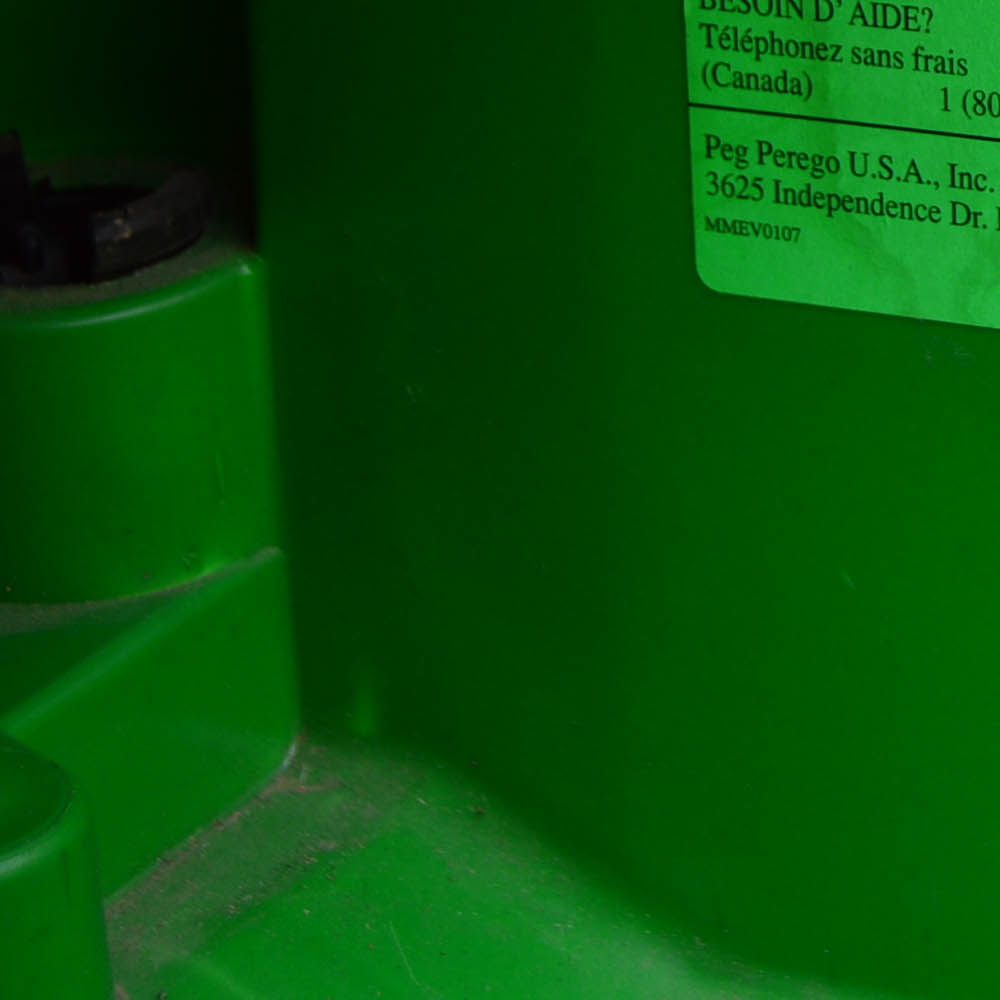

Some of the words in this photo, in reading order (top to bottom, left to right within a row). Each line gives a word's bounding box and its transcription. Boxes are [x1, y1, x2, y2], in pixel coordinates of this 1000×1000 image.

[848, 0, 934, 34] AIDE?
[698, 22, 844, 63] Téléphonez
[850, 45, 905, 70] sans
[911, 45, 969, 77] frais
[701, 61, 814, 101] (Canada)
[939, 86, 952, 113] 1
[703, 133, 749, 171] Peg
[756, 139, 841, 180] Perego
[847, 150, 940, 190] U.S.A.,
[947, 162, 995, 193] Inc.
[705, 170, 765, 202] 3625
[772, 178, 942, 224] Independence
[950, 200, 988, 230] Dr.
[703, 215, 802, 244] MMEV0107
